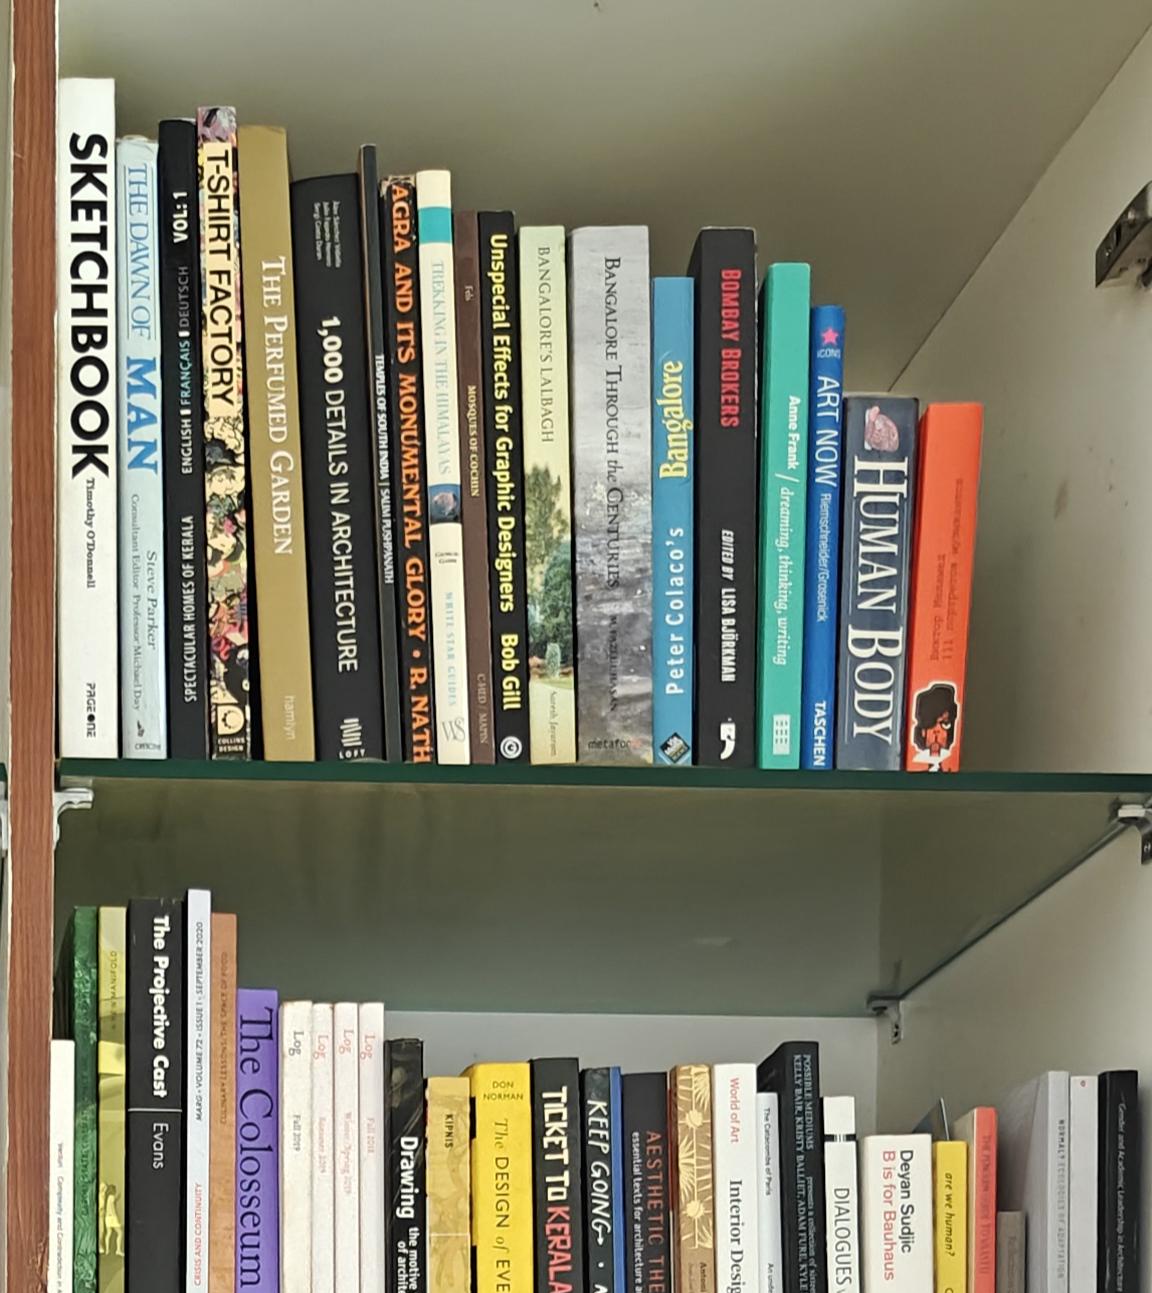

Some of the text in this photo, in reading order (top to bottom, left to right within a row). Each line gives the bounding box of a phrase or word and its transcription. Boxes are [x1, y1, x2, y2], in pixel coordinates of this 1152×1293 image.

[205, 150, 234, 407] T-SHIRT FACTORY
[68, 132, 110, 588] SKETCHBOOK Timothy O'Donnell
[260, 256, 295, 554] THE PERFUMED GARDEN
[720, 269, 741, 427] BOMBAY BROKERS
[126, 355, 158, 474] MAN
[657, 360, 692, 478] Bangalore
[848, 455, 909, 745] HUMAN BODY
[812, 701, 826, 766] TASCHEN
[148, 915, 171, 1098] The Projective Cast
[238, 1007, 274, 1075] The
[152, 1122, 168, 1169] Evans
[238, 1088, 274, 1288] Colosseum
[395, 1136, 418, 1219] Drawing
[898, 1150, 915, 1253] Deyan Sudjic
[729, 1179, 746, 1245] Interior
[833, 1187, 851, 1285] DIALOGUES
